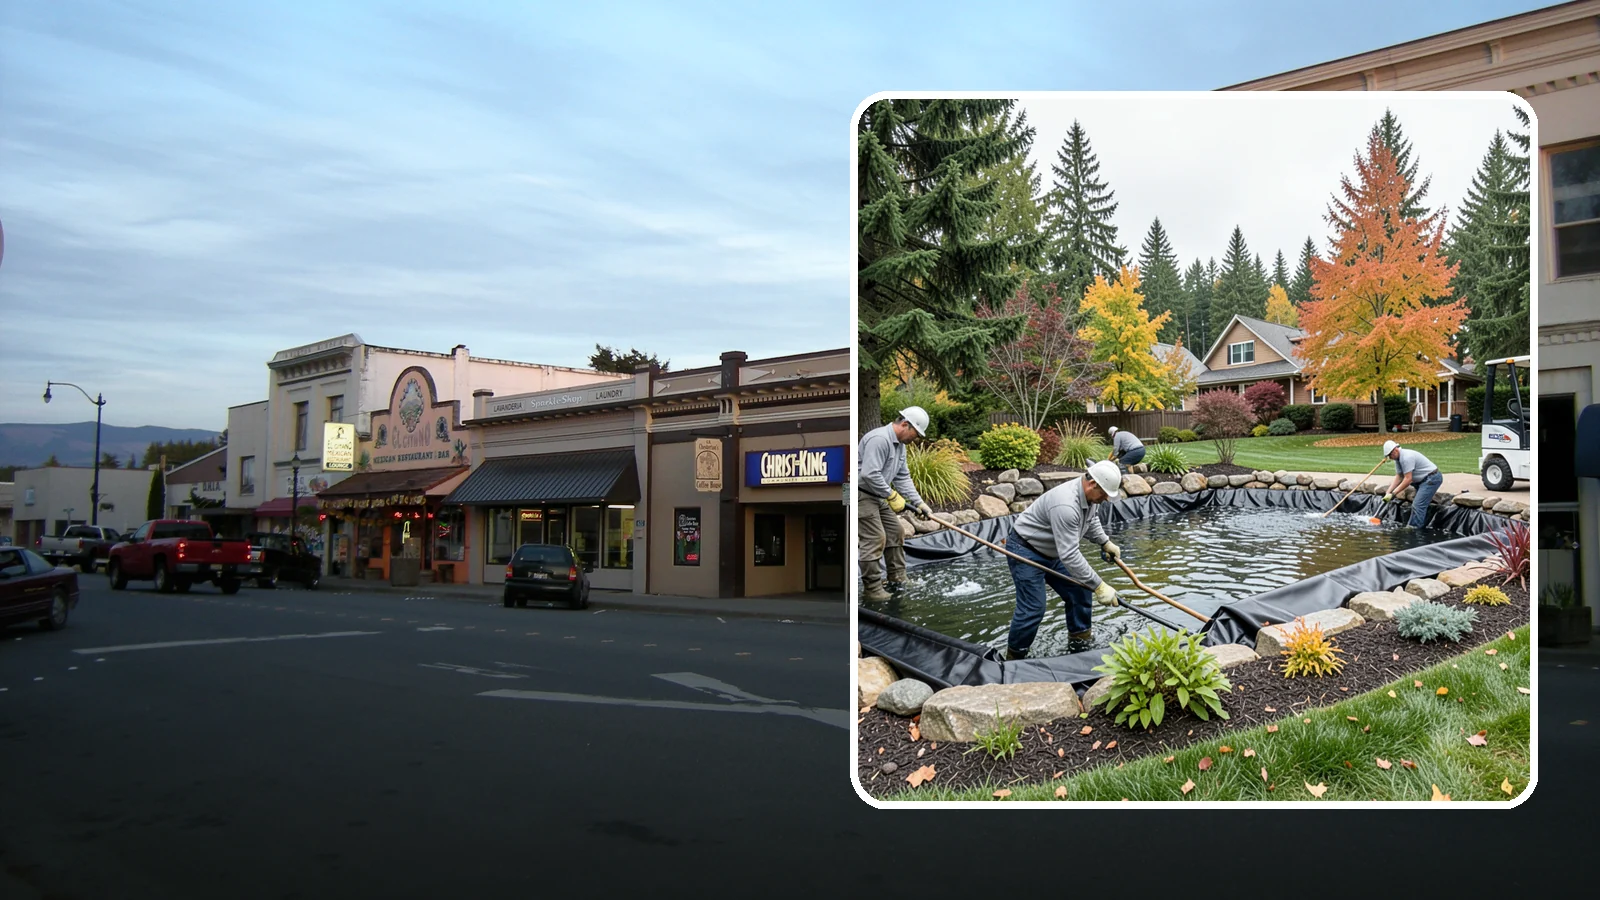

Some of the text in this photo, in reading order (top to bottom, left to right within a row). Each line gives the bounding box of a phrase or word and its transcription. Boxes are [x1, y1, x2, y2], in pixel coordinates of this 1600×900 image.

[493, 402, 523, 413] LAVANDERIA
[595, 389, 623, 400] LAUNDRY
[397, 451, 433, 462] RESTAURANT
[437, 450, 450, 459] BAR
[799, 450, 827, 476] KING
